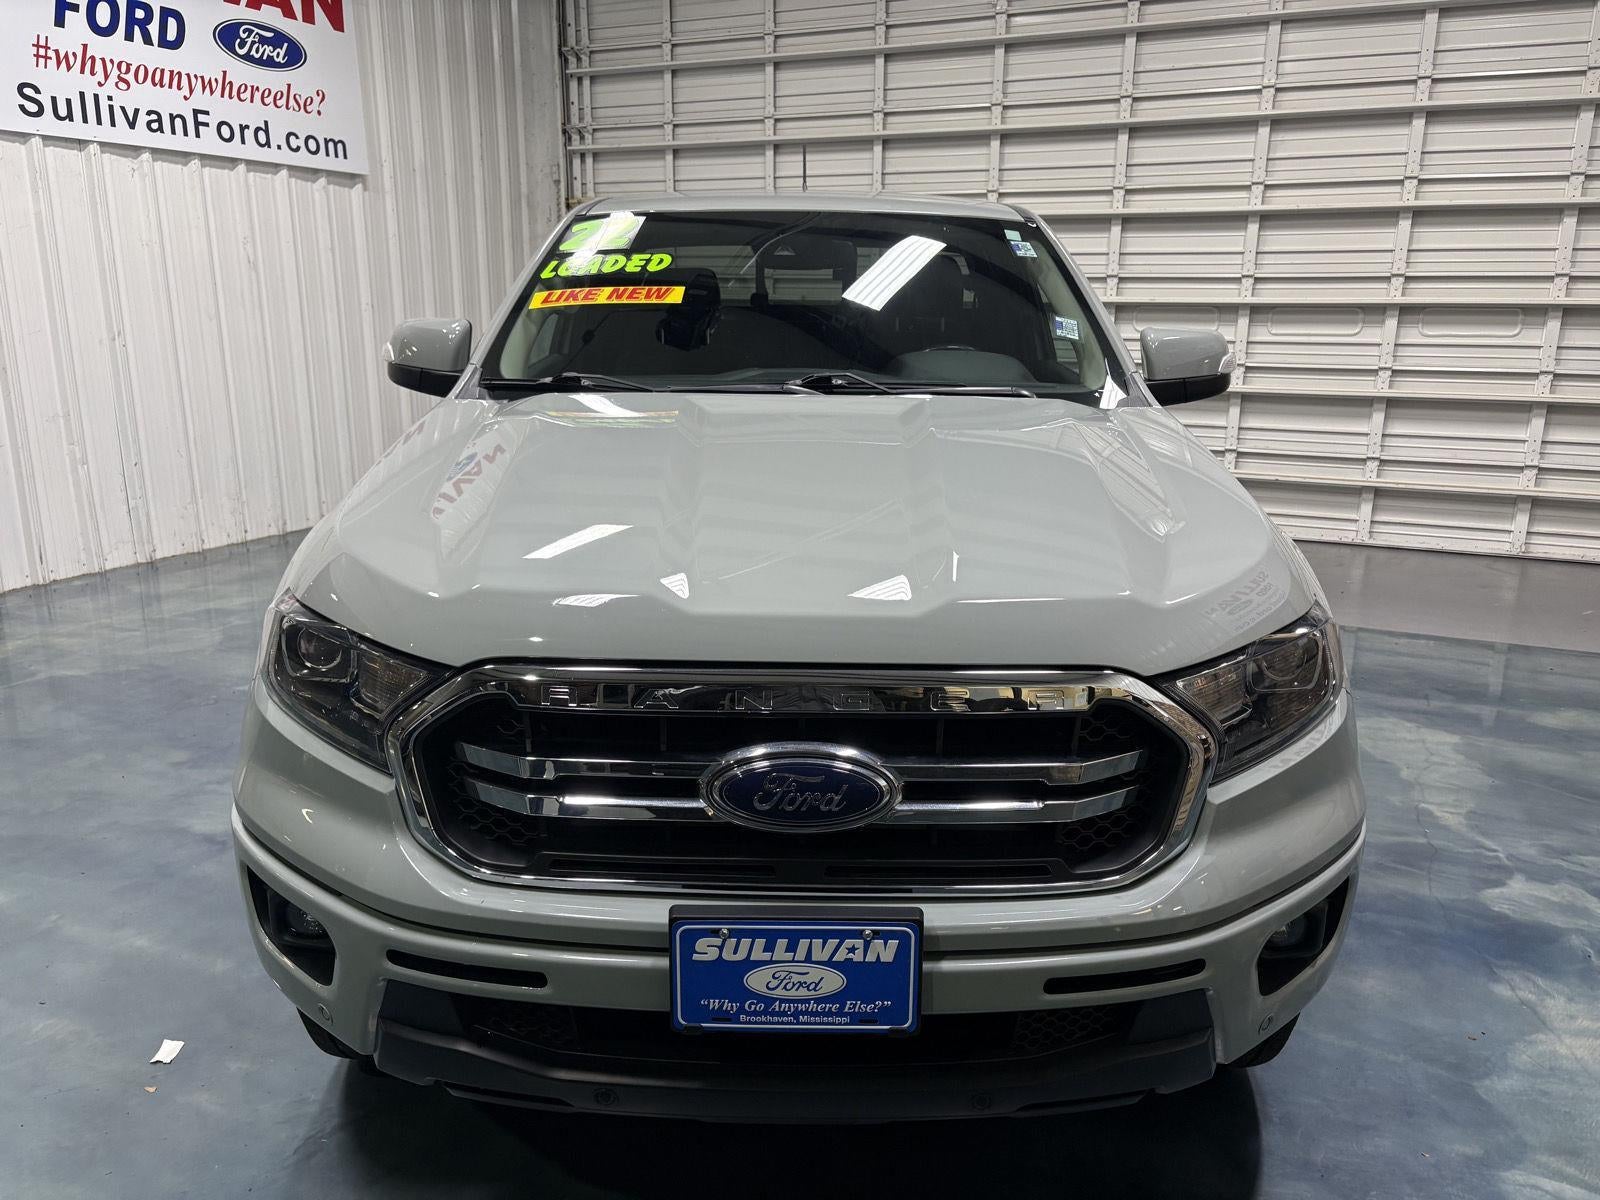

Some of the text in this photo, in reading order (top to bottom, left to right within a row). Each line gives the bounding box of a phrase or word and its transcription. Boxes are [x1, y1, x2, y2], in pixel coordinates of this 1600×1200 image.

[54, 0, 186, 51] FORD
[235, 24, 288, 64] Ford
[32, 34, 326, 116] #whygoanywhereelse?
[17, 82, 348, 160] SullivanFord.com
[540, 253, 673, 280] LOADED
[541, 287, 673, 304] LIKE NEW
[541, 684, 1066, 710] RANGER
[754, 773, 847, 812] Ford
[692, 937, 899, 963] SULLIVAN
[765, 969, 824, 993] Ford
[739, 1014, 851, 1025] Brookhaven, Mississippi
[745, 1000, 765, 1013] Go
[768, 1000, 840, 1015] Anywhere
